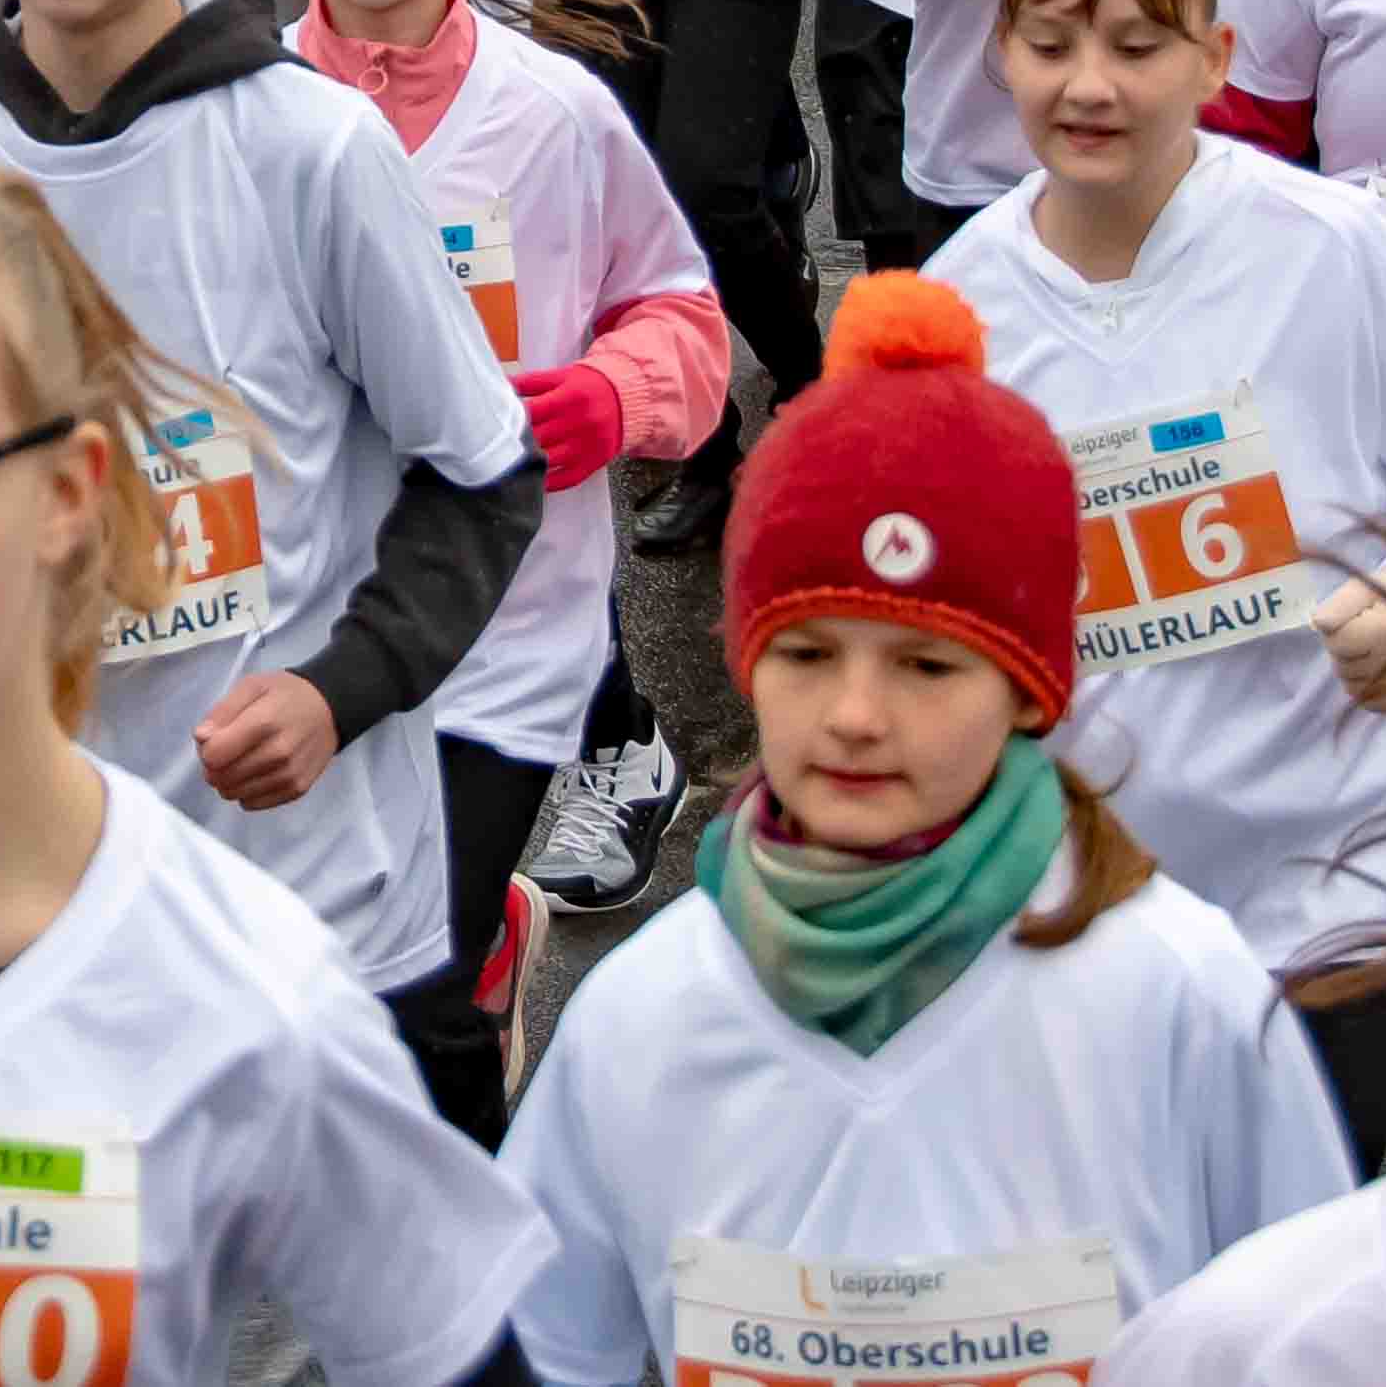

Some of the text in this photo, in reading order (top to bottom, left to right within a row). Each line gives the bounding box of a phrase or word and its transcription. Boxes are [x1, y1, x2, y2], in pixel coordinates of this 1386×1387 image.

[1180, 492, 1246, 580] 6
[829, 1269, 947, 1296] Leipziger
[731, 1319, 1051, 1369] 68. Oberschule
